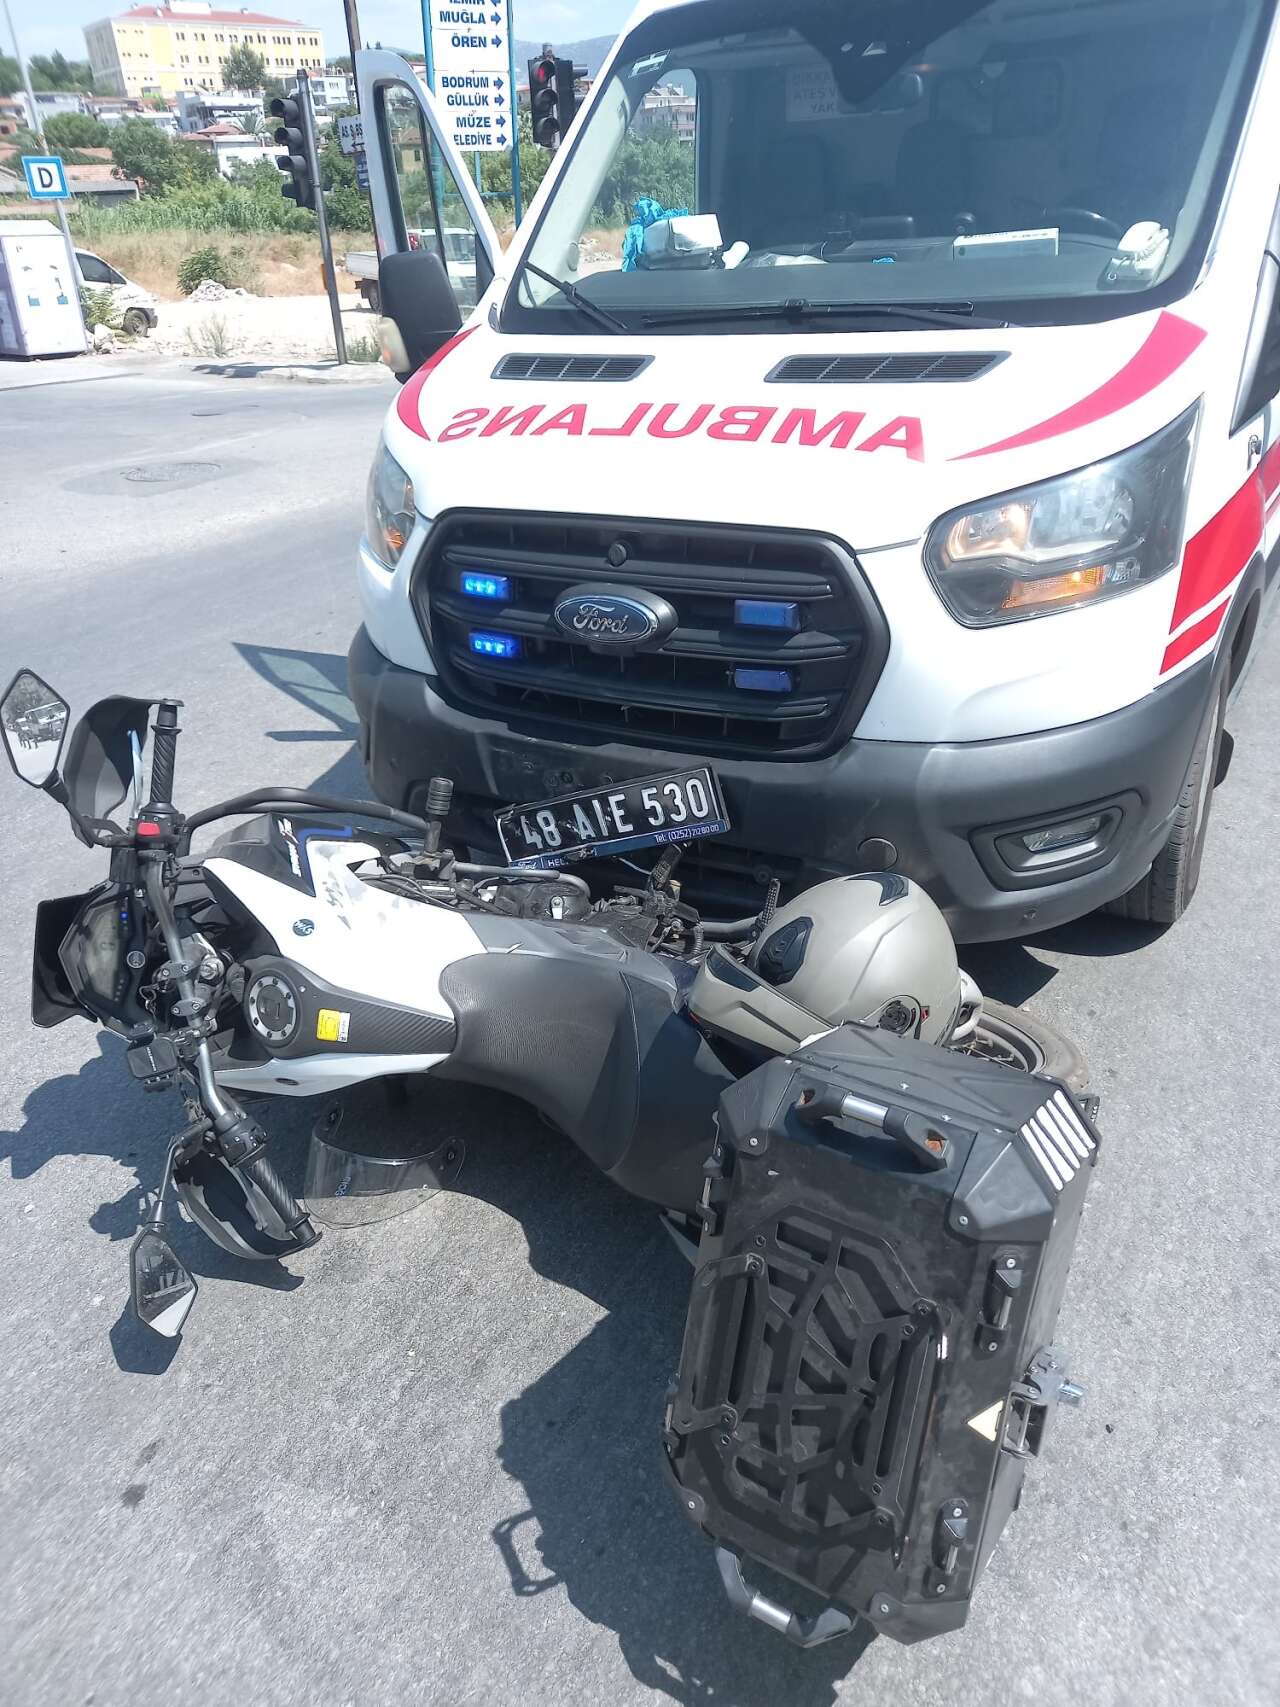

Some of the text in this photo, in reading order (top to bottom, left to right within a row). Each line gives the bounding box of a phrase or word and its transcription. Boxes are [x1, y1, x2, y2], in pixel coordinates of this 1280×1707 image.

[440, 9, 486, 24] MUĞLA
[451, 32, 487, 48] ÖREN
[442, 76, 489, 88] BODRUM
[447, 92, 489, 106] GÜLLÜK
[456, 113, 491, 128] MÜZE
[453, 131, 492, 146] ELEDİYE
[37, 167, 53, 188] D
[573, 603, 631, 634] Ford
[520, 810, 562, 849] 48
[641, 778, 709, 827] 530
[668, 828, 692, 842] (0252)
